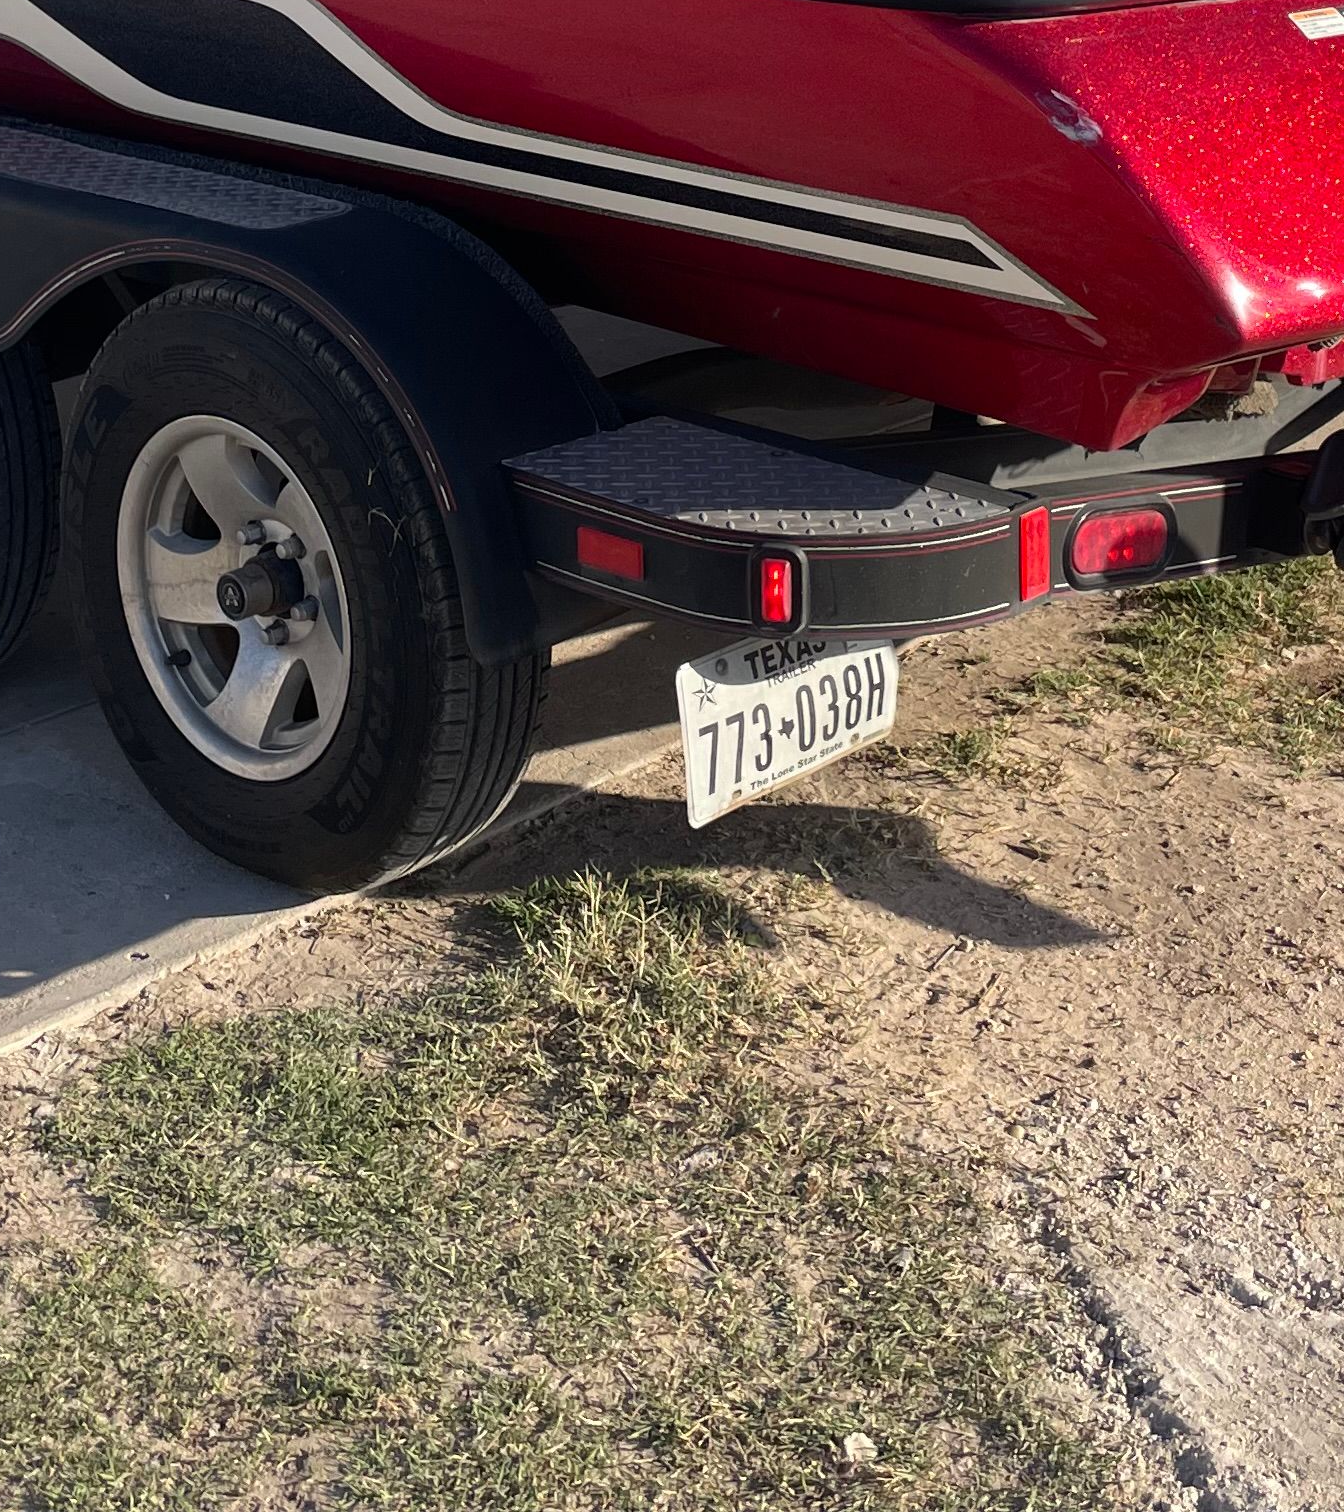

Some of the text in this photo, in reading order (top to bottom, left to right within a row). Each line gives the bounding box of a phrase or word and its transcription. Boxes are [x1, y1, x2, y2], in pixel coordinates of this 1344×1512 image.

[765, 658, 817, 688] TRAILER
[750, 740, 844, 791] The Lone Star State
